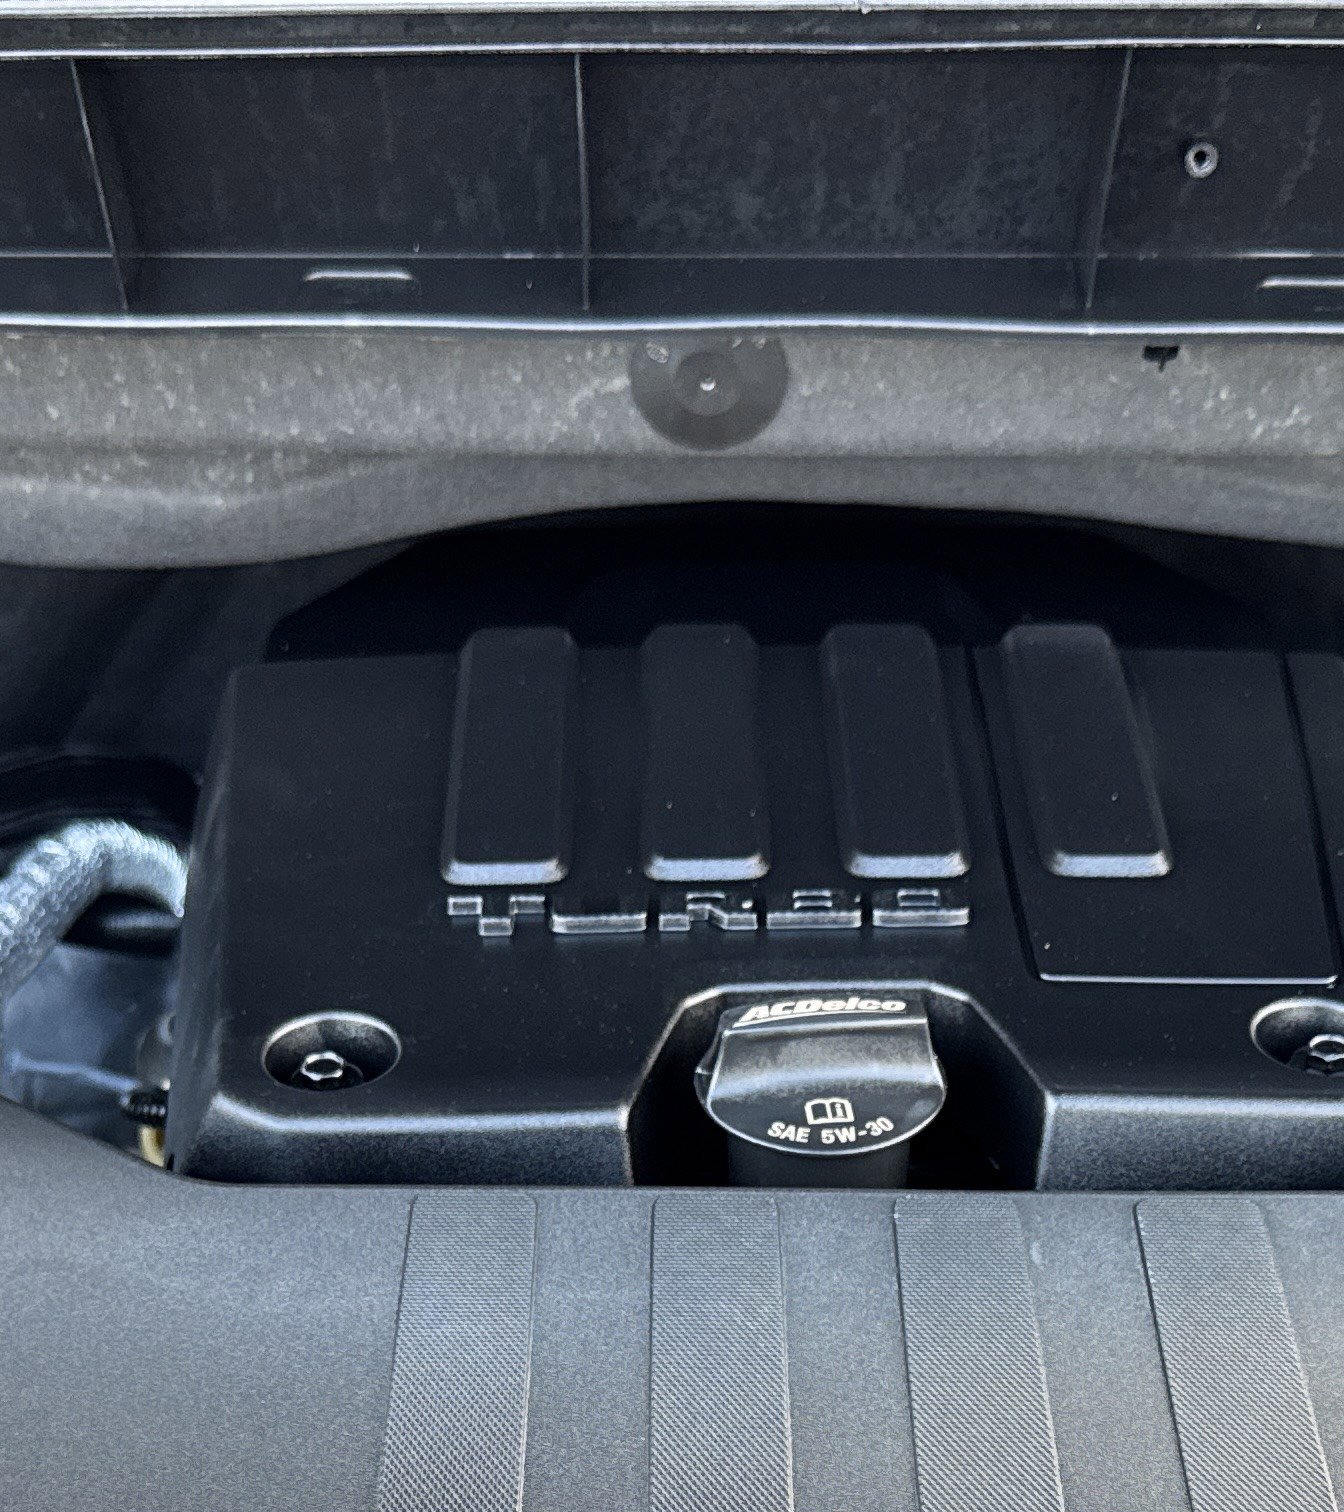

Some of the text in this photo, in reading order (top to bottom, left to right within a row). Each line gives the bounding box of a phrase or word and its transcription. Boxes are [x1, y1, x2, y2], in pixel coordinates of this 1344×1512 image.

[734, 996, 907, 1027] ACDelco
[767, 1115, 894, 1144] SAE 5W-30
